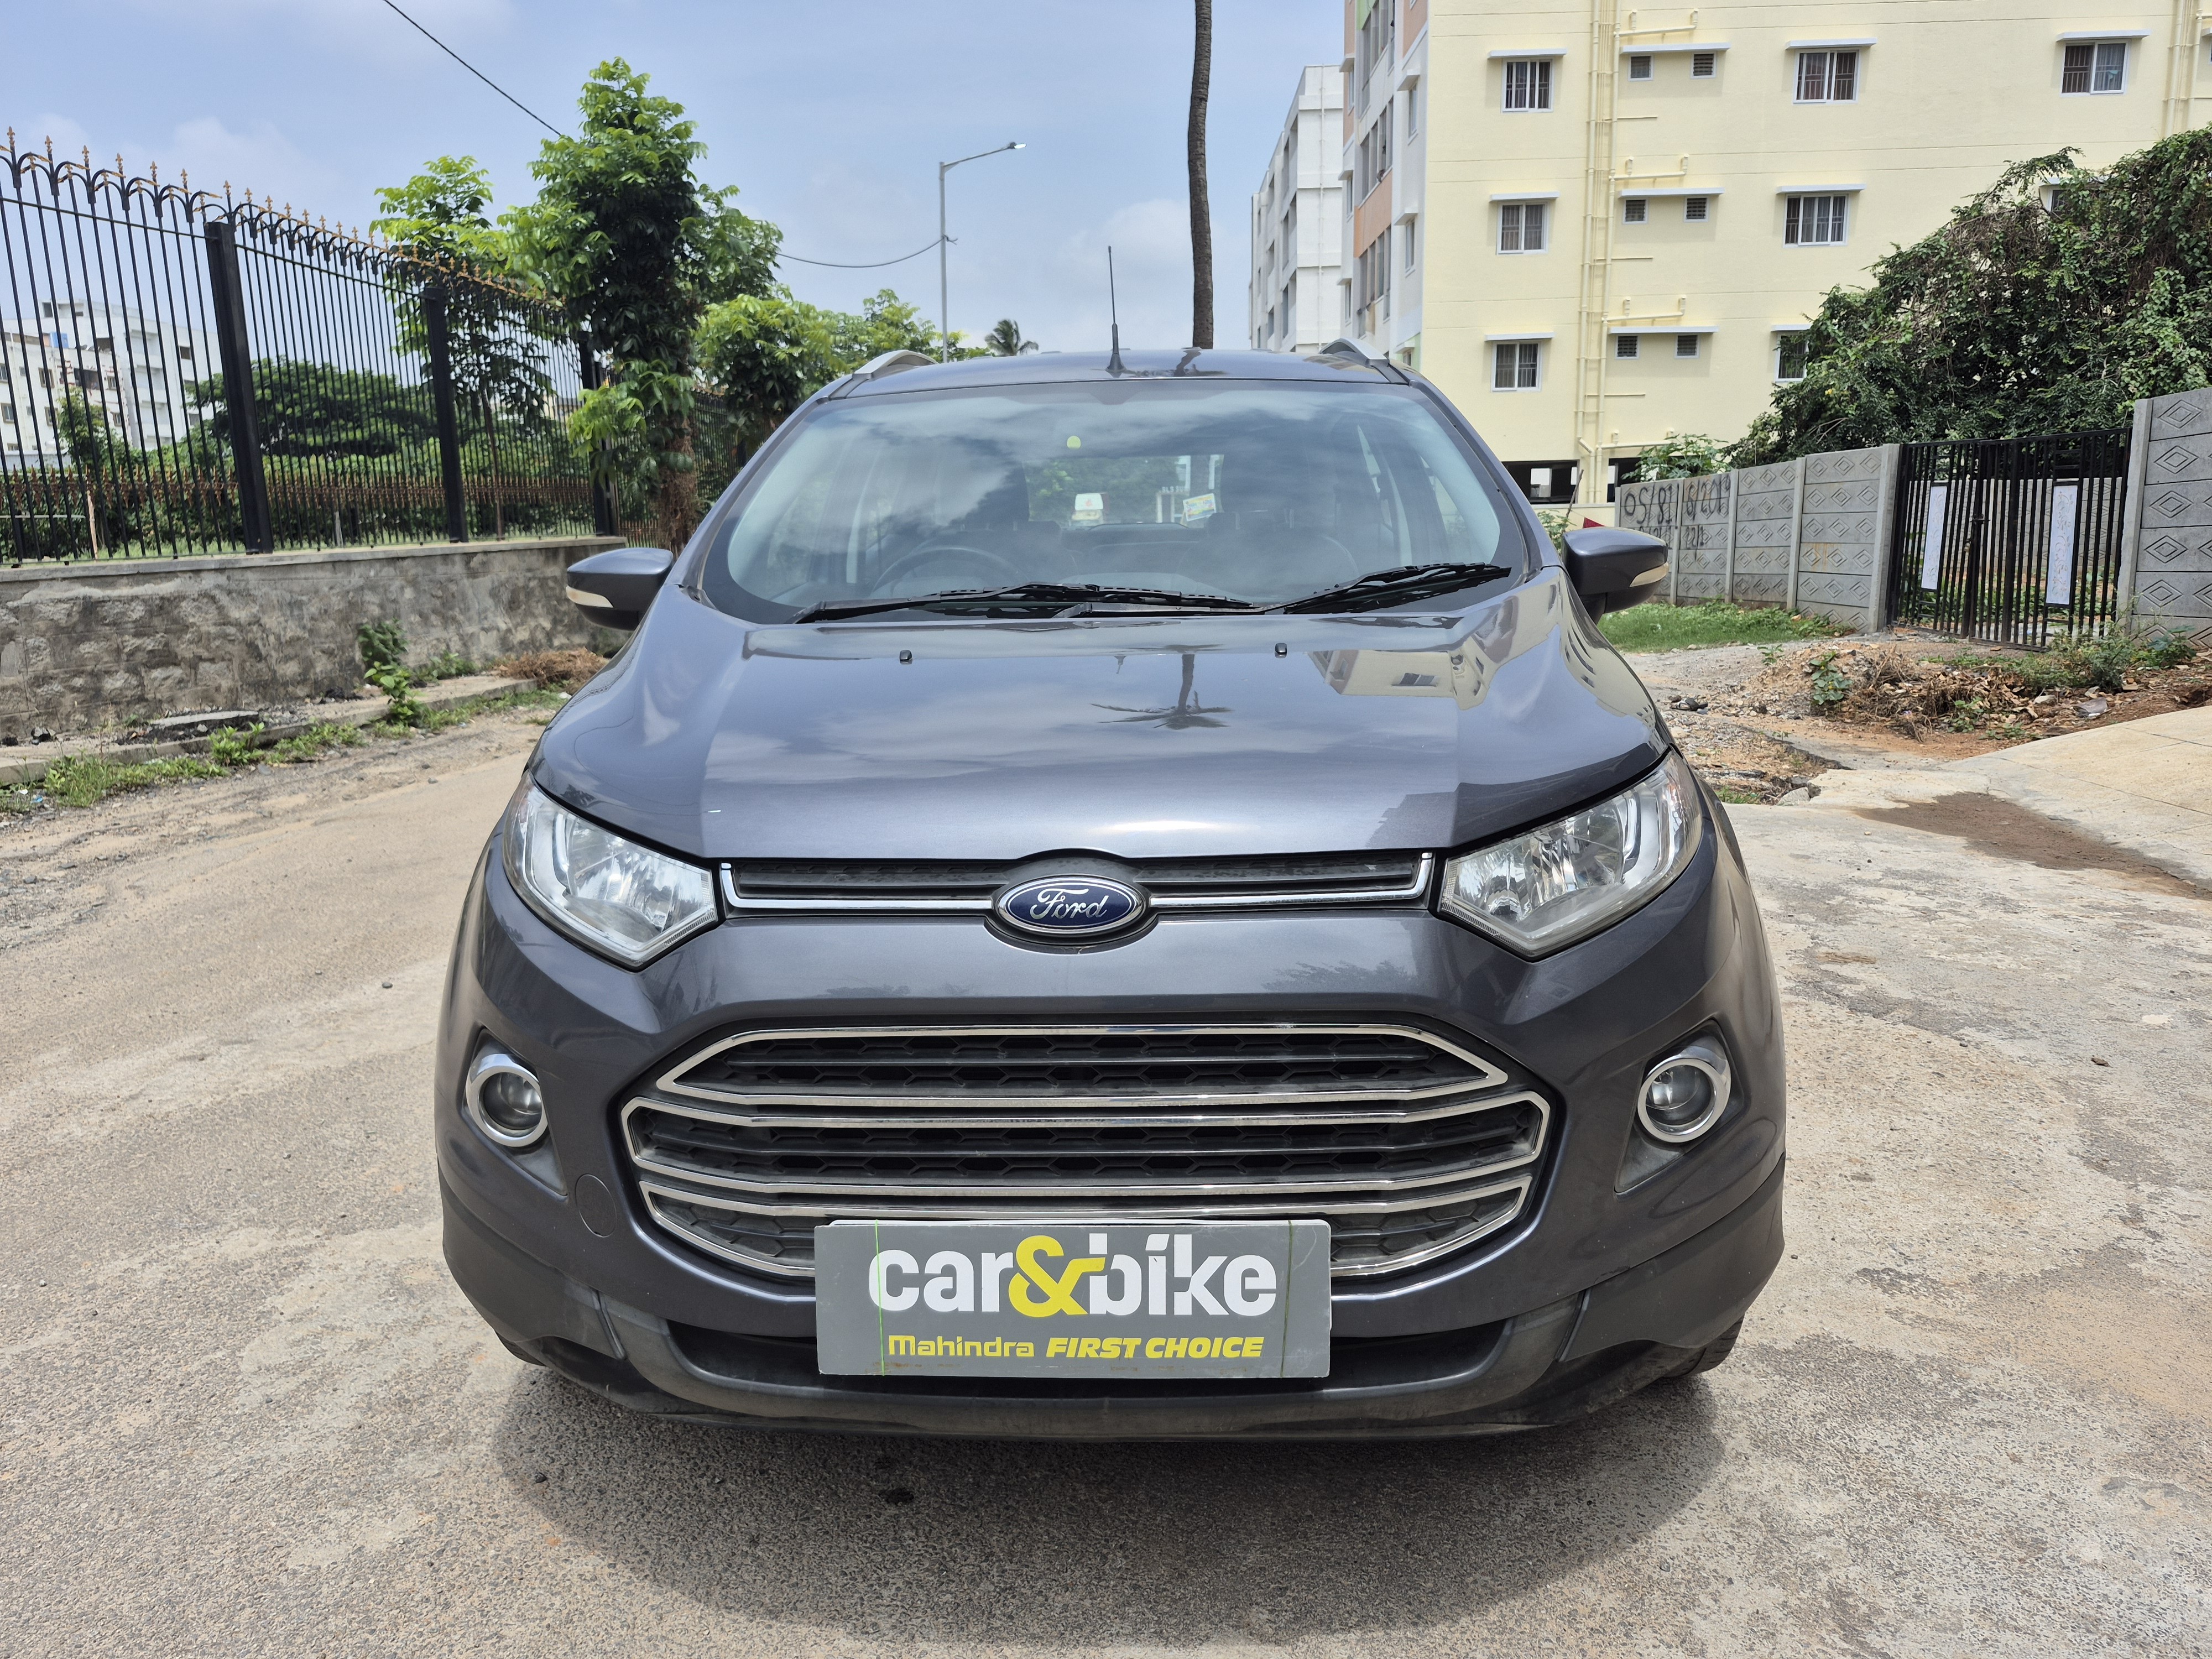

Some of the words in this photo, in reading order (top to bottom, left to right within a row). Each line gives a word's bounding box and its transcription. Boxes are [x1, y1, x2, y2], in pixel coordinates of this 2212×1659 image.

[1030, 888, 1109, 919] Ford
[868, 1233, 1277, 1317] car&bike
[888, 1335, 1035, 1358] Mahindra
[1046, 1337, 1142, 1359] FIRST
[1145, 1336, 1264, 1359] CHOICE
